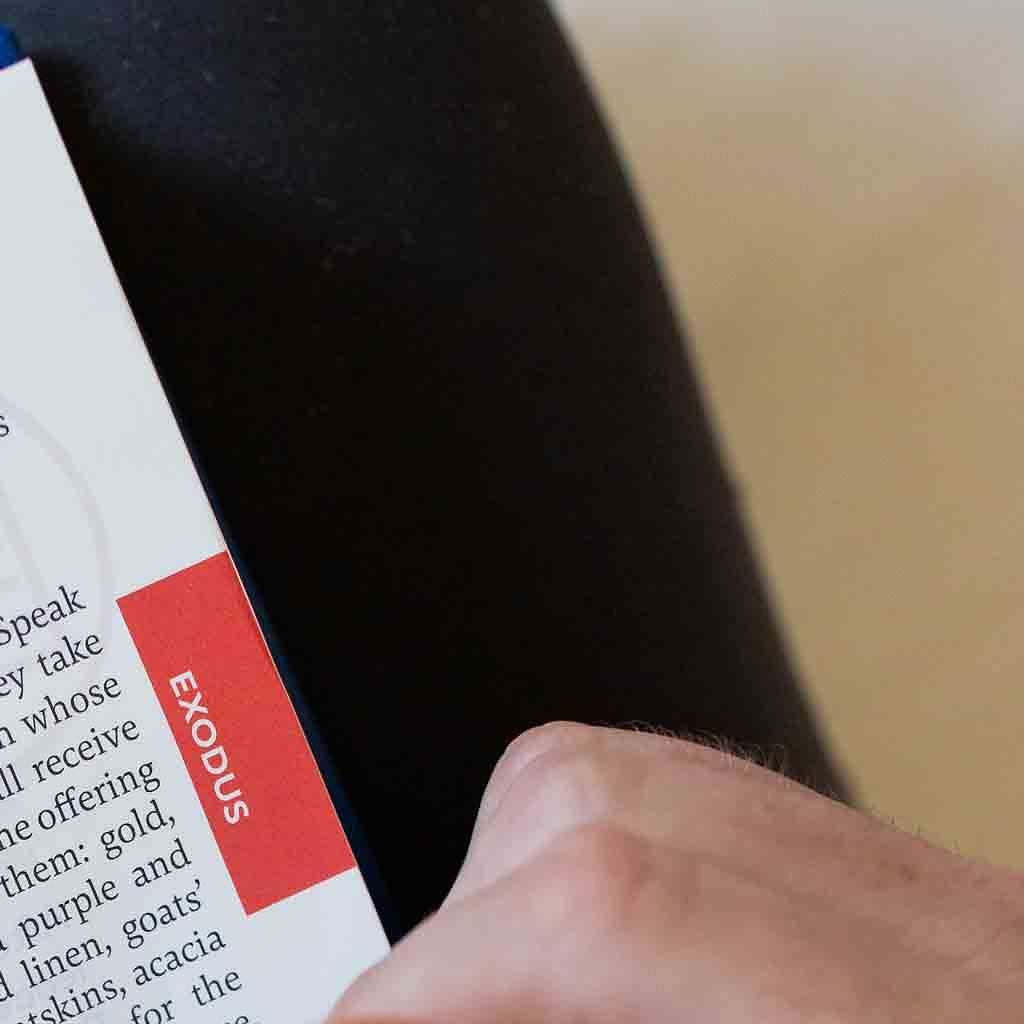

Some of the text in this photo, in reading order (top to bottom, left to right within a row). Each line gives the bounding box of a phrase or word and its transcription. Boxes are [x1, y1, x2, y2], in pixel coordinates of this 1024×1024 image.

[36, 634, 104, 677] take
[32, 720, 140, 783] receive
[169, 670, 250, 825] EXODUS
[0, 844, 89, 898] them:
[100, 799, 176, 861] gold,
[19, 938, 112, 989] linen,
